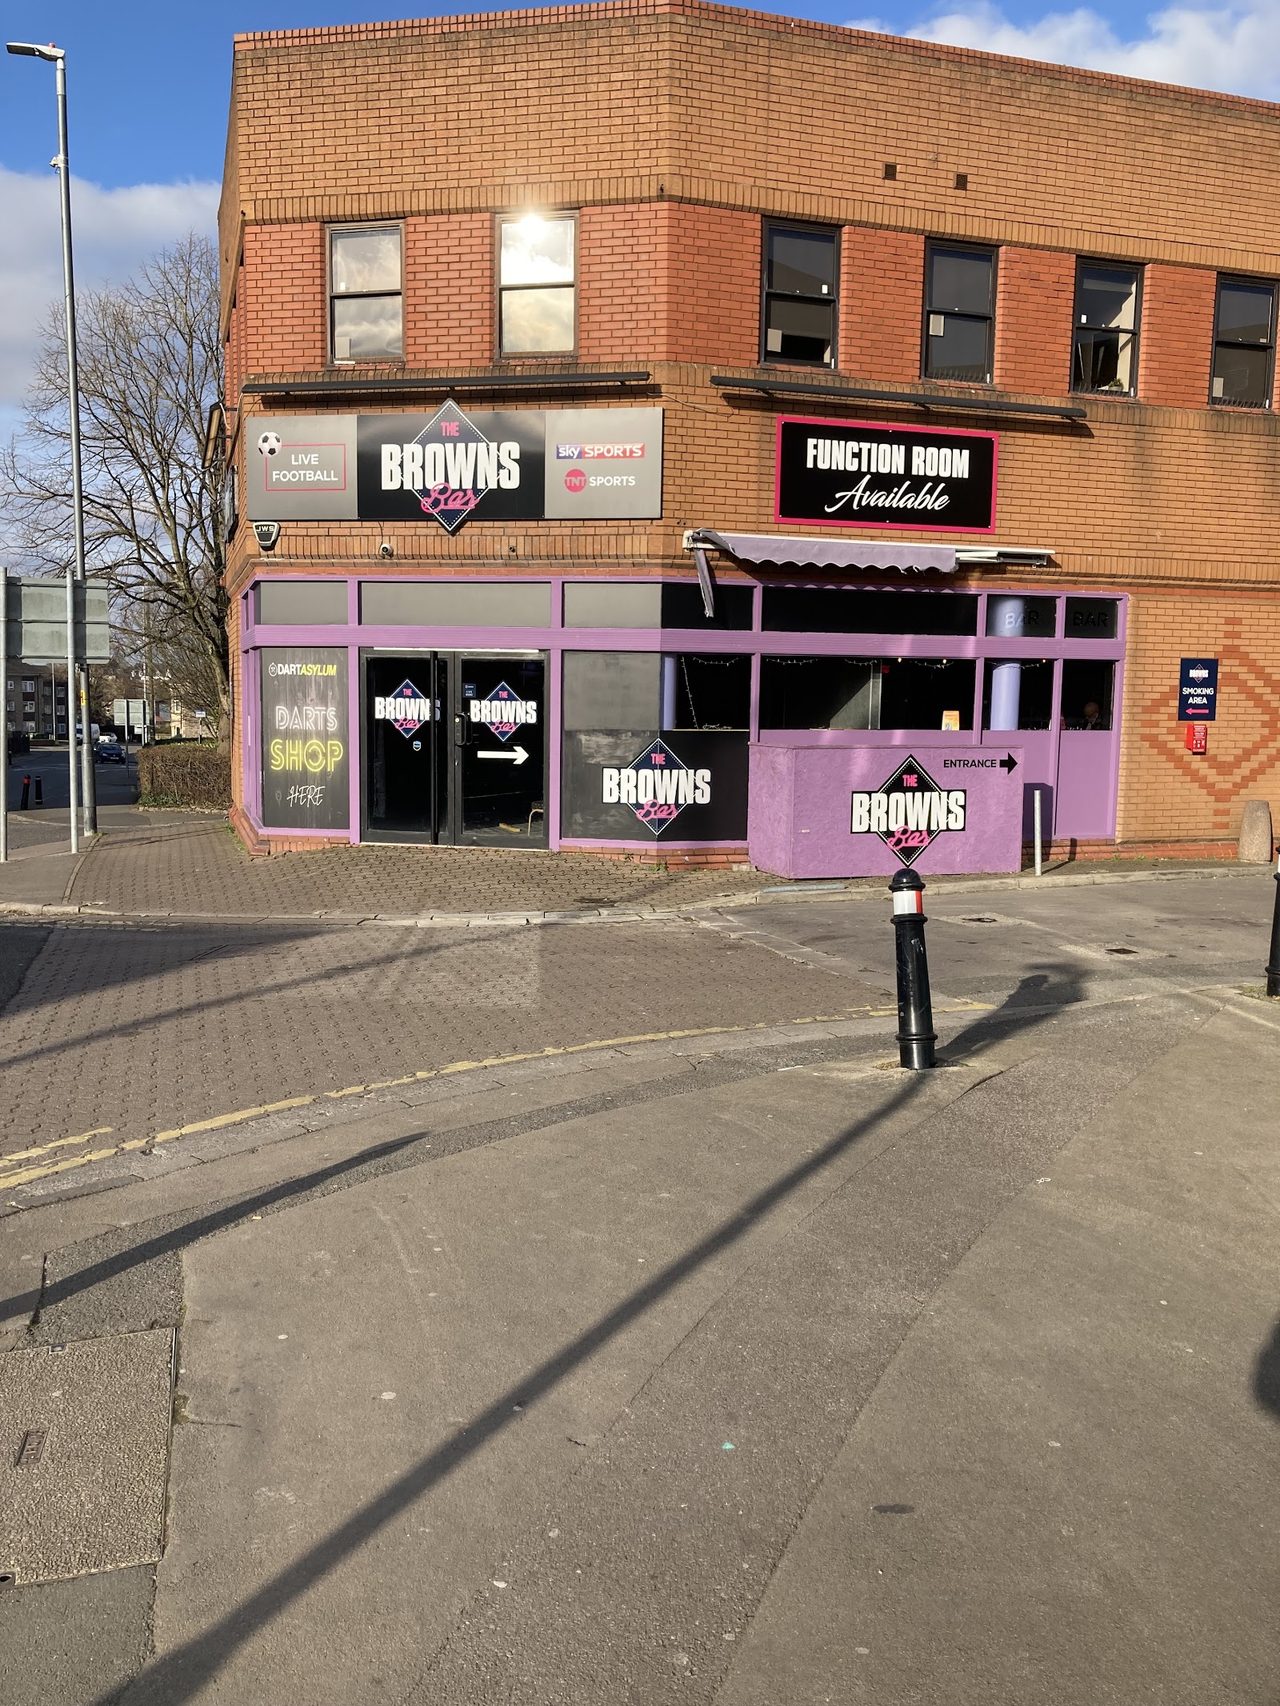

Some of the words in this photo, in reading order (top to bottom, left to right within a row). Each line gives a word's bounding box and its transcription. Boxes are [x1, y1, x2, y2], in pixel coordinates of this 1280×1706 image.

[441, 421, 460, 437] THE
[291, 453, 319, 465] LIVE
[558, 445, 580, 459] sky
[584, 445, 643, 457] SPORTS
[806, 437, 906, 475] FUNCTION
[911, 445, 970, 479] ROOM
[381, 441, 521, 490] BROWNS
[272, 470, 339, 482] FOOTBALL
[565, 477, 585, 487] TNT
[589, 476, 636, 487] SPORTS
[420, 482, 480, 514] Bar
[824, 474, 951, 513] Available
[1005, 610, 1040, 629] BAR
[278, 664, 337, 676] DARTASYLUM
[403, 688, 413, 696] THE
[498, 691, 509, 699] THE
[1182, 687, 1214, 695] SMOKING
[1188, 696, 1208, 704] AREA
[275, 705, 338, 731] DARTS
[470, 700, 537, 723] BROWNS
[270, 738, 344, 772] SHOP
[651, 753, 665, 765] THE
[943, 759, 997, 768] ENTRANCE
[602, 768, 711, 804] BROWNS
[902, 774, 918, 787] THE
[286, 785, 326, 808] HERE
[636, 799, 677, 821] Bar
[852, 791, 966, 832] BROWNS
[886, 825, 930, 850] Bar
